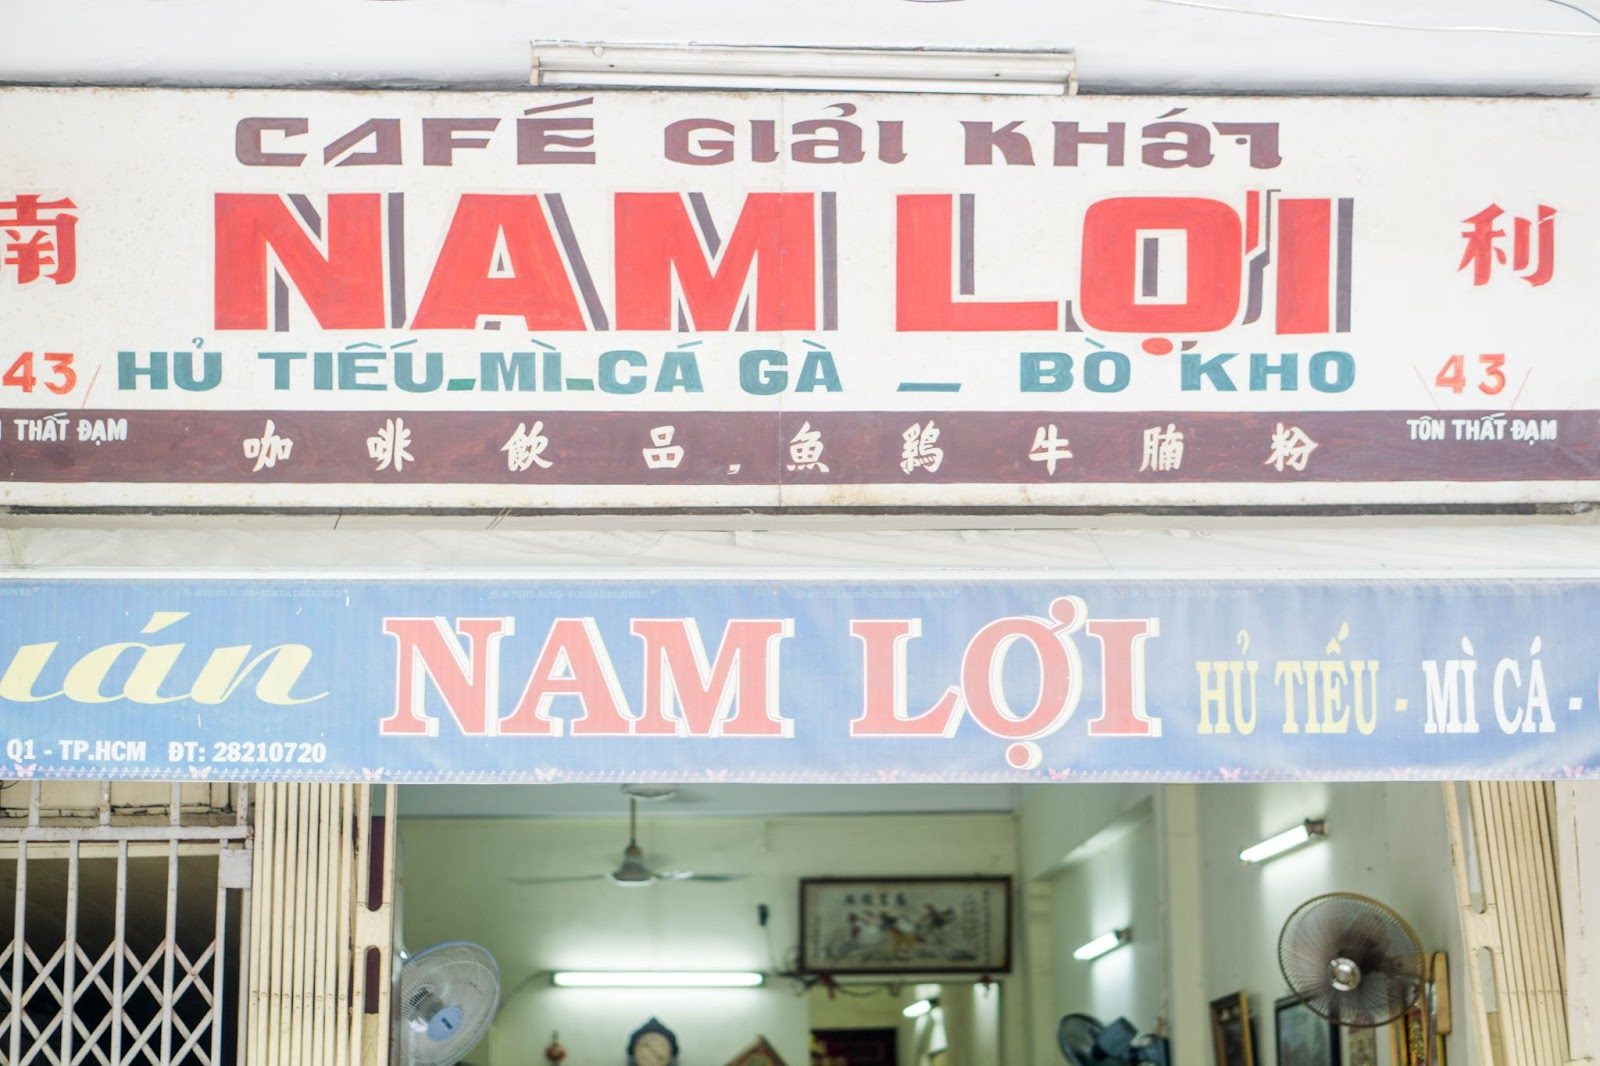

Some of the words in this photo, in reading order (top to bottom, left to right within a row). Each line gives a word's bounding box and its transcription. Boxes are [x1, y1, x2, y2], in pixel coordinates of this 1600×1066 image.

[235, 97, 596, 166] CAFÉ
[0, 194, 79, 285] 南
[1456, 202, 1559, 288] 利
[213, 190, 838, 333] NAM
[895, 188, 1355, 356] LỢI
[2, 351, 78, 395] 43
[117, 336, 223, 393] HỦ
[738, 338, 844, 396] GÀ
[1020, 336, 1132, 394] BÒ
[1180, 349, 1356, 394] KHO
[1434, 353, 1507, 396] 43
[13, 411, 71, 442] THẤT
[76, 418, 129, 446] ĐẠM
[1405, 415, 1447, 442] TÔN
[1451, 412, 1508, 442] THẤT
[1509, 418, 1559, 446] ĐẠM
[378, 616, 795, 739] NAM
[848, 594, 1163, 770] LỢI
[1195, 629, 1260, 736] HỦ
[1273, 621, 1381, 736] TIẾU
[1422, 636, 1480, 734] MÌ
[1493, 635, 1556, 735] CÁ
[6, 738, 36, 763] Q1
[58, 739, 147, 763] TP.HCM
[167, 741, 207, 763] ĐT:
[212, 741, 328, 764] 28210720
